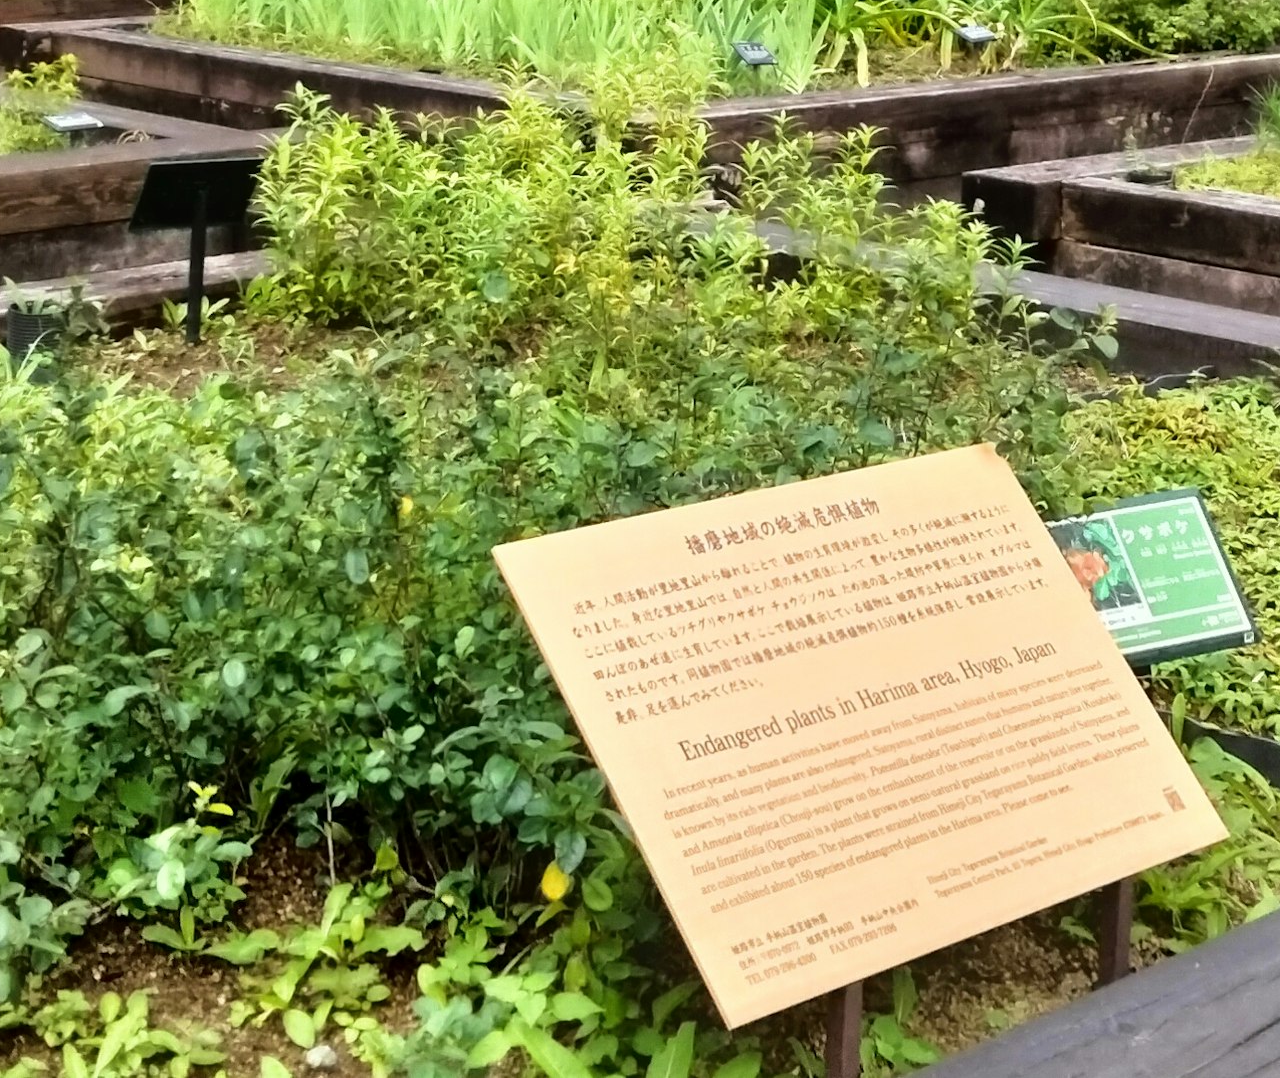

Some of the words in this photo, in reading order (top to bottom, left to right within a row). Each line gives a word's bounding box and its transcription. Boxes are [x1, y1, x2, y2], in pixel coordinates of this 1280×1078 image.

[684, 497, 879, 555] 播磨地域の絶滅危惧植物
[1122, 519, 1189, 545] クサボケ
[677, 715, 782, 760] Endangered
[785, 705, 836, 734] plants
[836, 697, 856, 715] in
[856, 682, 919, 709] Harima
[920, 671, 960, 690] area,
[958, 656, 1013, 678] Hyogo,
[1012, 642, 1056, 663] Japan
[682, 842, 701, 857] and
[702, 832, 742, 851] Amsonia
[833, 797, 854, 810] grow
[855, 792, 867, 801] on
[867, 787, 881, 797] the
[882, 769, 936, 792] embankment
[936, 764, 945, 775] of
[944, 762, 959, 772] the
[959, 750, 994, 767] reservoir
[995, 747, 1004, 756] or
[1005, 744, 1016, 753] on
[1015, 740, 1028, 749] the
[1069, 721, 1077, 732] of
[1116, 706, 1130, 717] and
[690, 860, 716, 876] Inula
[814, 827, 823, 835] is
[830, 816, 853, 832] plant
[853, 810, 871, 822] that
[871, 803, 897, 818] grows
[898, 799, 910, 808] on
[961, 767, 1000, 789] grassland
[1000, 765, 1011, 774] on
[1010, 760, 1026, 770] rice
[1027, 751, 1050, 767] paddy
[1049, 745, 1067, 757] field
[1093, 731, 1116, 742] These
[1116, 723, 1140, 737] plants
[701, 883, 717, 894] are
[717, 865, 761, 888] cultivated
[760, 865, 771, 874] in
[771, 860, 786, 870] the
[818, 842, 837, 854] The
[837, 834, 864, 851] plants
[864, 827, 885, 839] were
[918, 809, 939, 821] from
[937, 798, 966, 814] Himeji
[964, 794, 982, 805] City
[1026, 764, 1063, 784] Botanical
[1092, 750, 1114, 762] which
[1113, 737, 1149, 756] preserved
[710, 898, 729, 913] and
[729, 884, 770, 907] exhibited
[770, 877, 796, 892] about
[795, 869, 813, 883] 150
[814, 861, 846, 878] species
[846, 854, 855, 866] of
[855, 838, 904, 863] endangered
[903, 832, 929, 849] plants
[928, 829, 938, 838] in
[938, 825, 952, 834] the
[950, 815, 983, 830] Harima
[1001, 798, 1028, 813] Please
[1028, 792, 1049, 803] come
